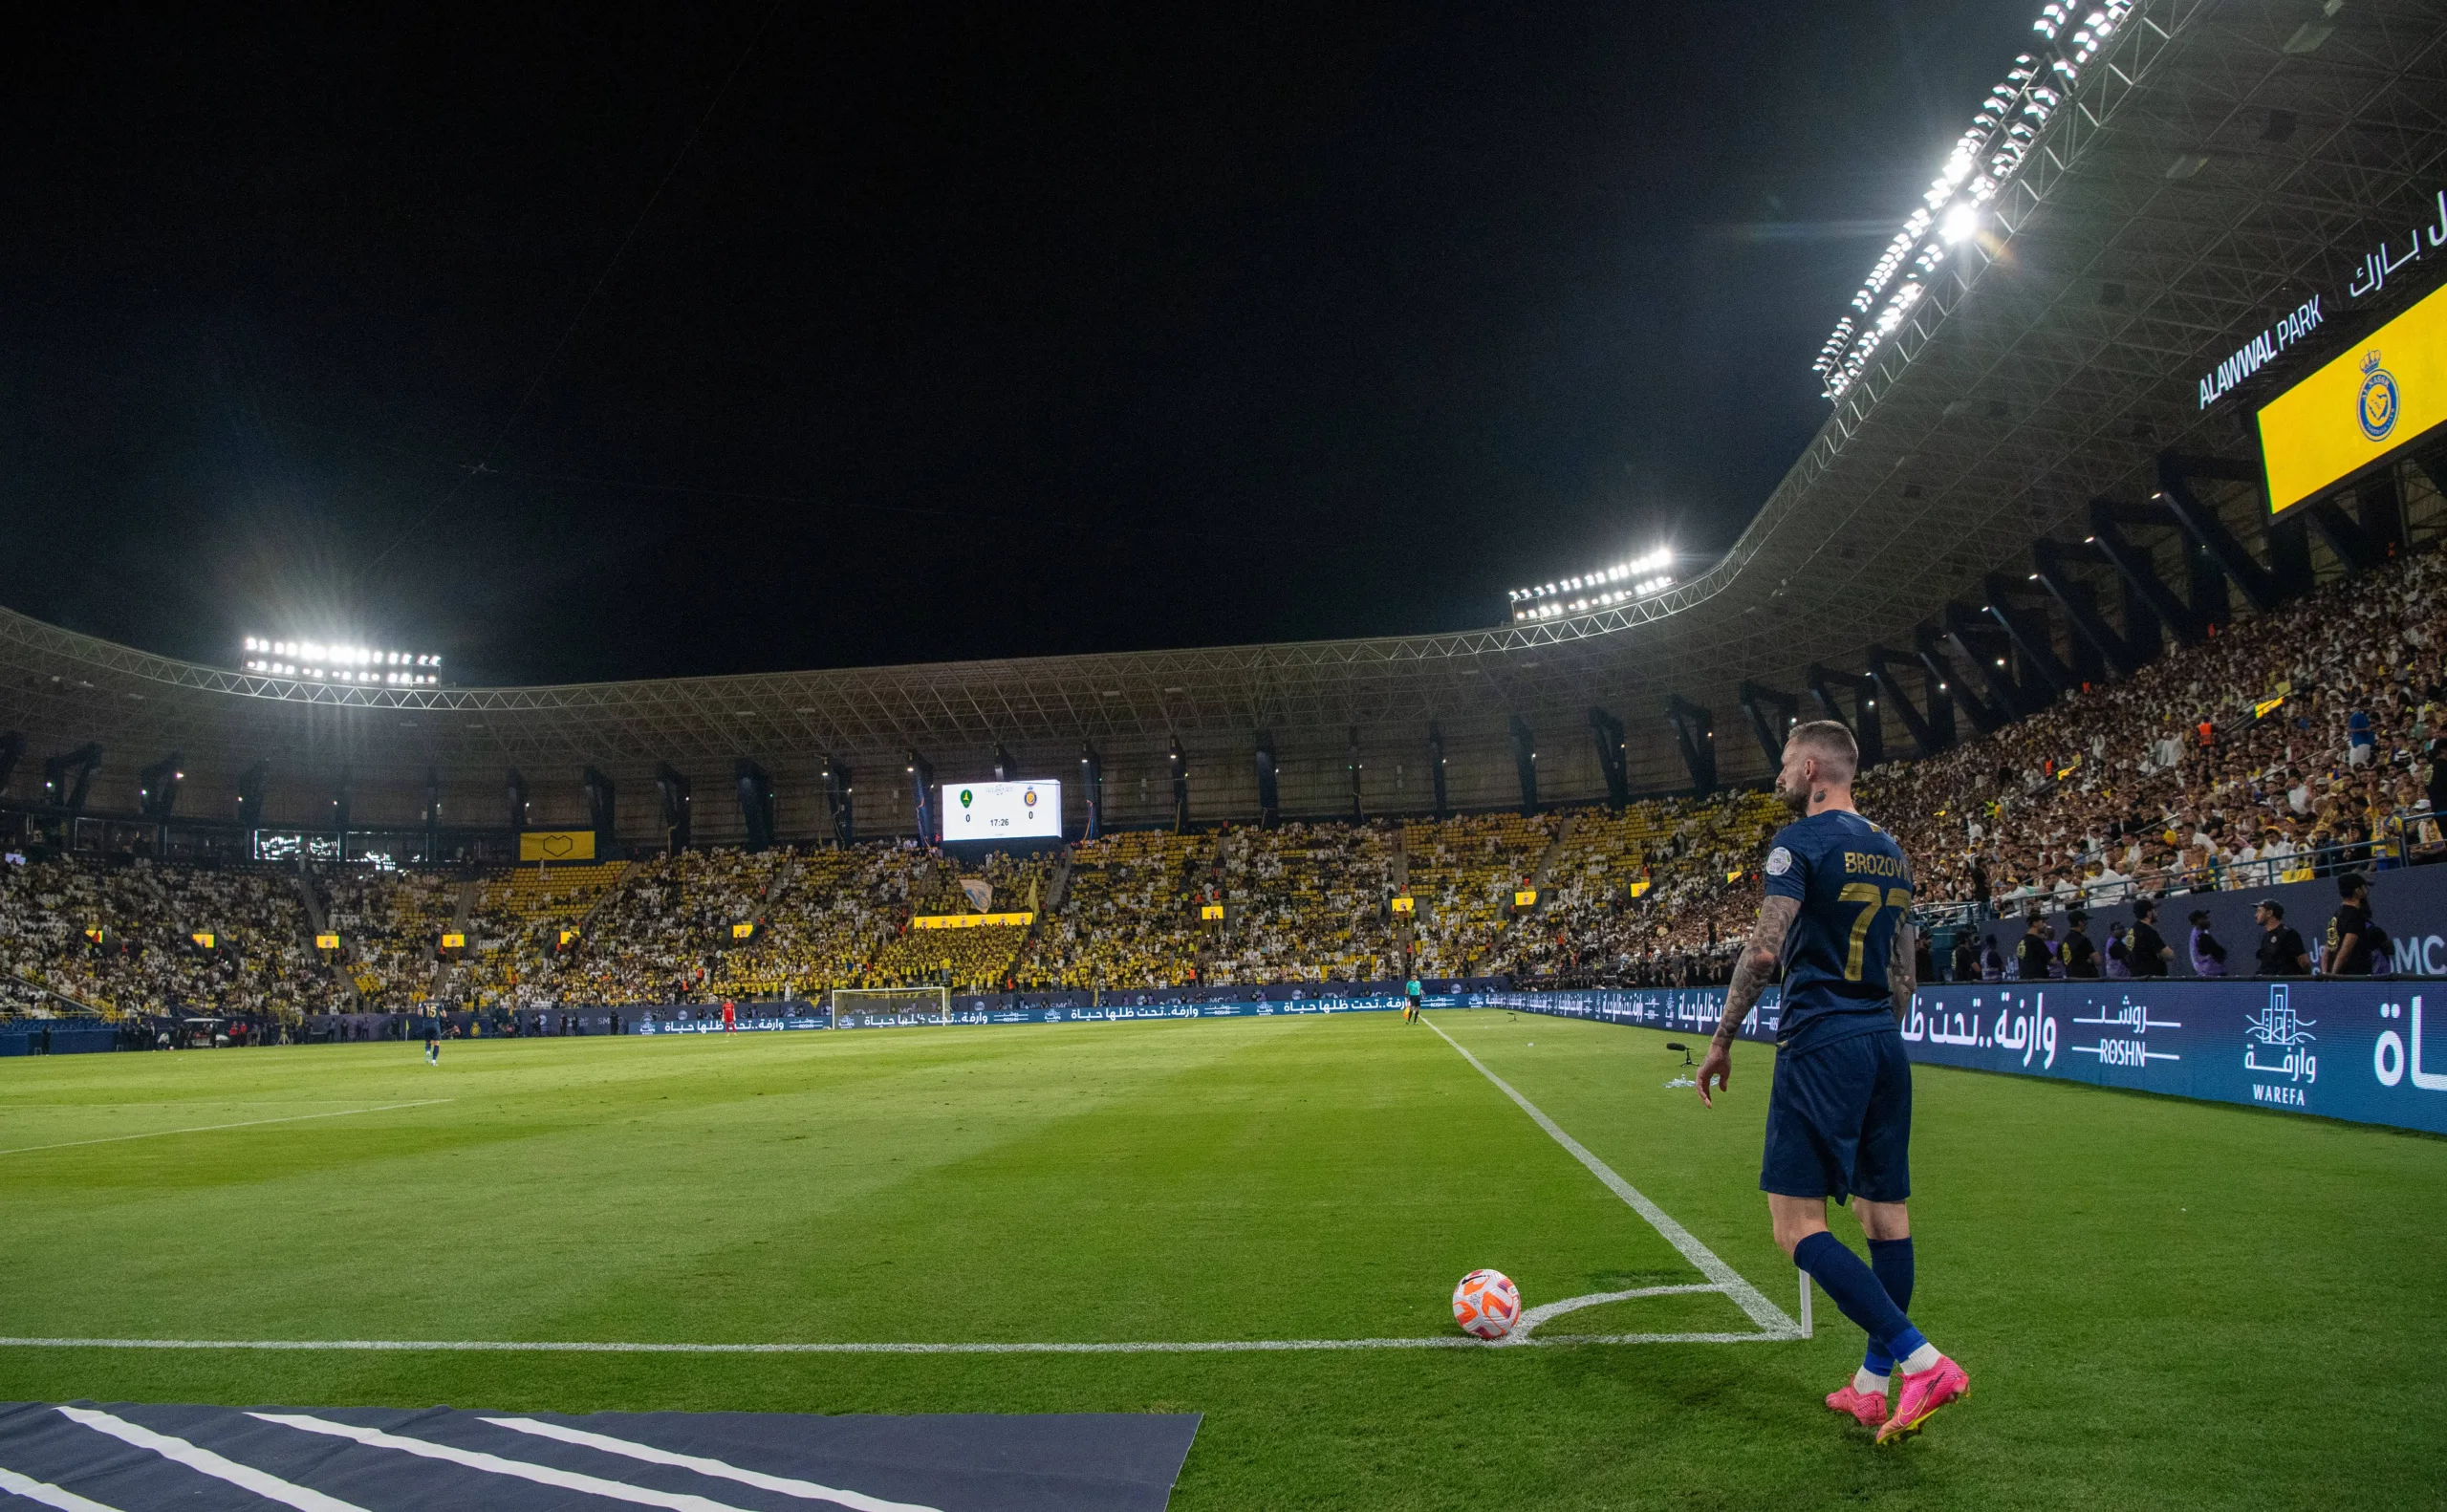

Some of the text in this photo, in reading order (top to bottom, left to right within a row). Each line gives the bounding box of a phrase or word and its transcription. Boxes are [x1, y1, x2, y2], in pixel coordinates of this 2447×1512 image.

[2199, 293, 2324, 410] ALAWWAL PARK
[990, 818, 1009, 827] 17:26
[1029, 810, 1033, 820] 0
[2390, 935, 2447, 976] MC
[425, 1005, 437, 1018] 15
[2099, 1038, 2146, 1068] ROSHN
[2243, 1044, 2317, 1084] وارفة
[2252, 1083, 2306, 1107] WAREFA
